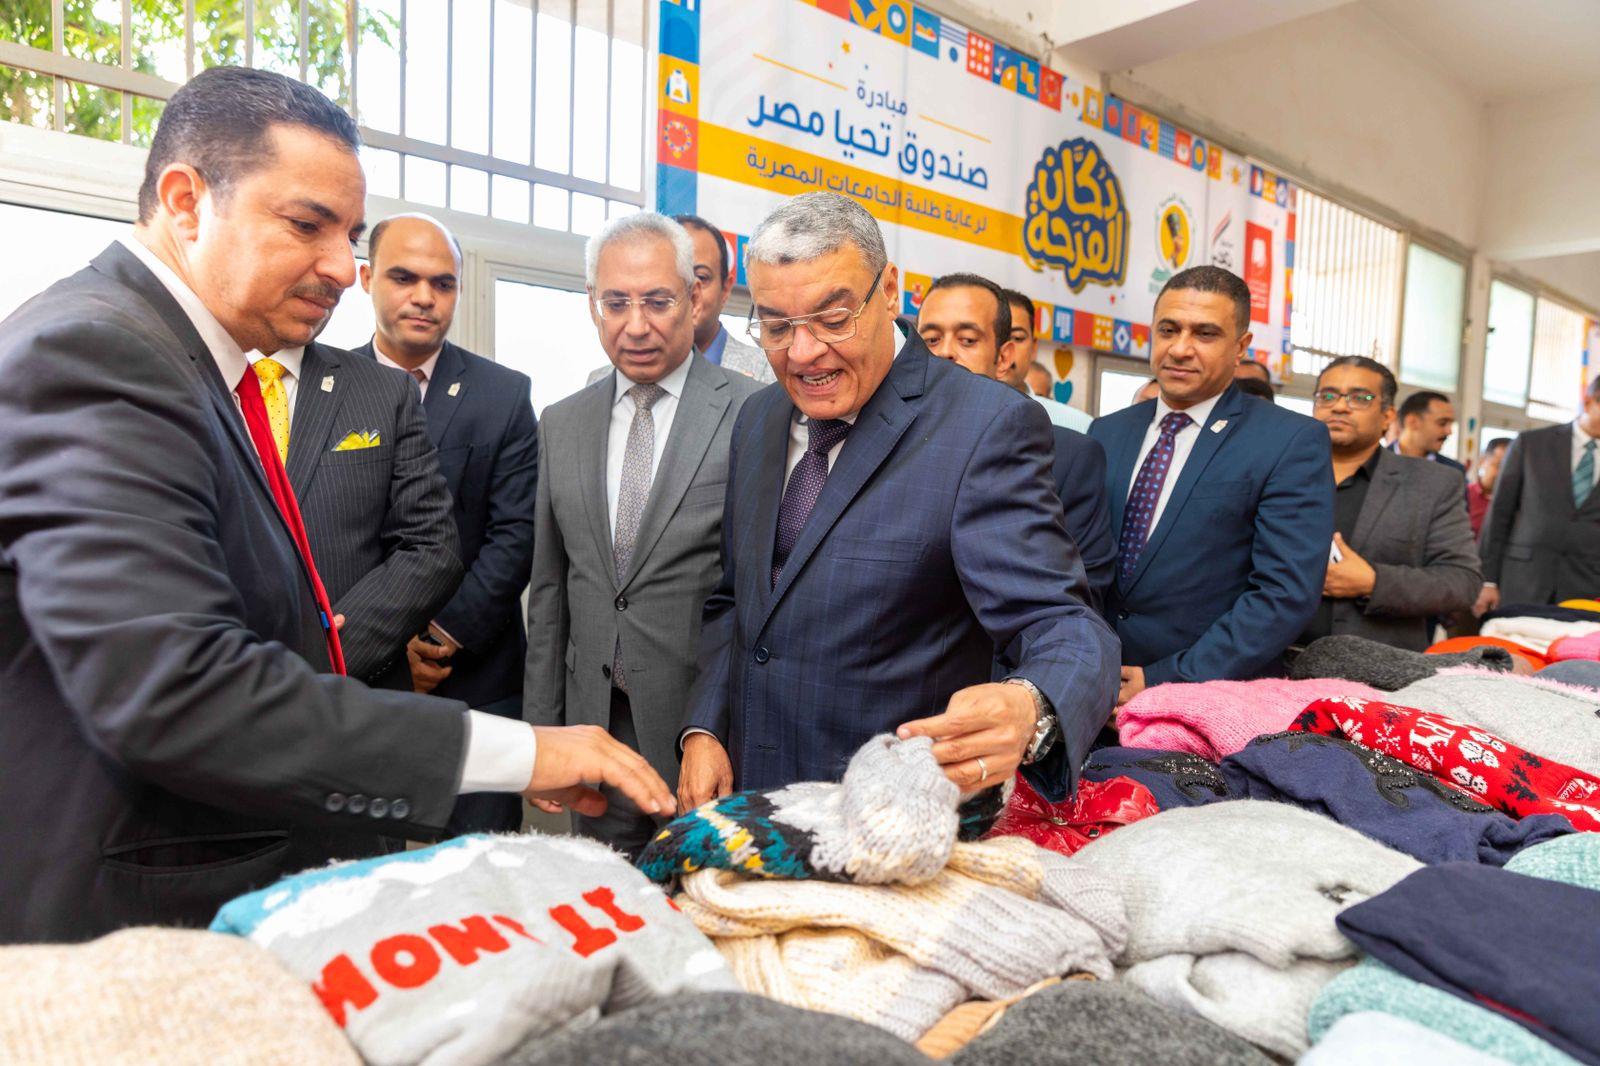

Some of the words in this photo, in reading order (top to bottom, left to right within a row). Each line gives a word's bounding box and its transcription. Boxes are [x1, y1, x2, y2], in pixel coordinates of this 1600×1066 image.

[747, 95, 825, 137] مصر
[857, 80, 908, 118] مبادرة
[834, 109, 891, 159] تحيا
[747, 146, 823, 185] المصرية
[898, 130, 988, 190] صندوق
[826, 174, 902, 208] الجامعات
[905, 192, 941, 220] طلبة
[945, 205, 988, 235] لرعاية
[1409, 716, 1456, 767] RY
[549, 886, 646, 958] IT
